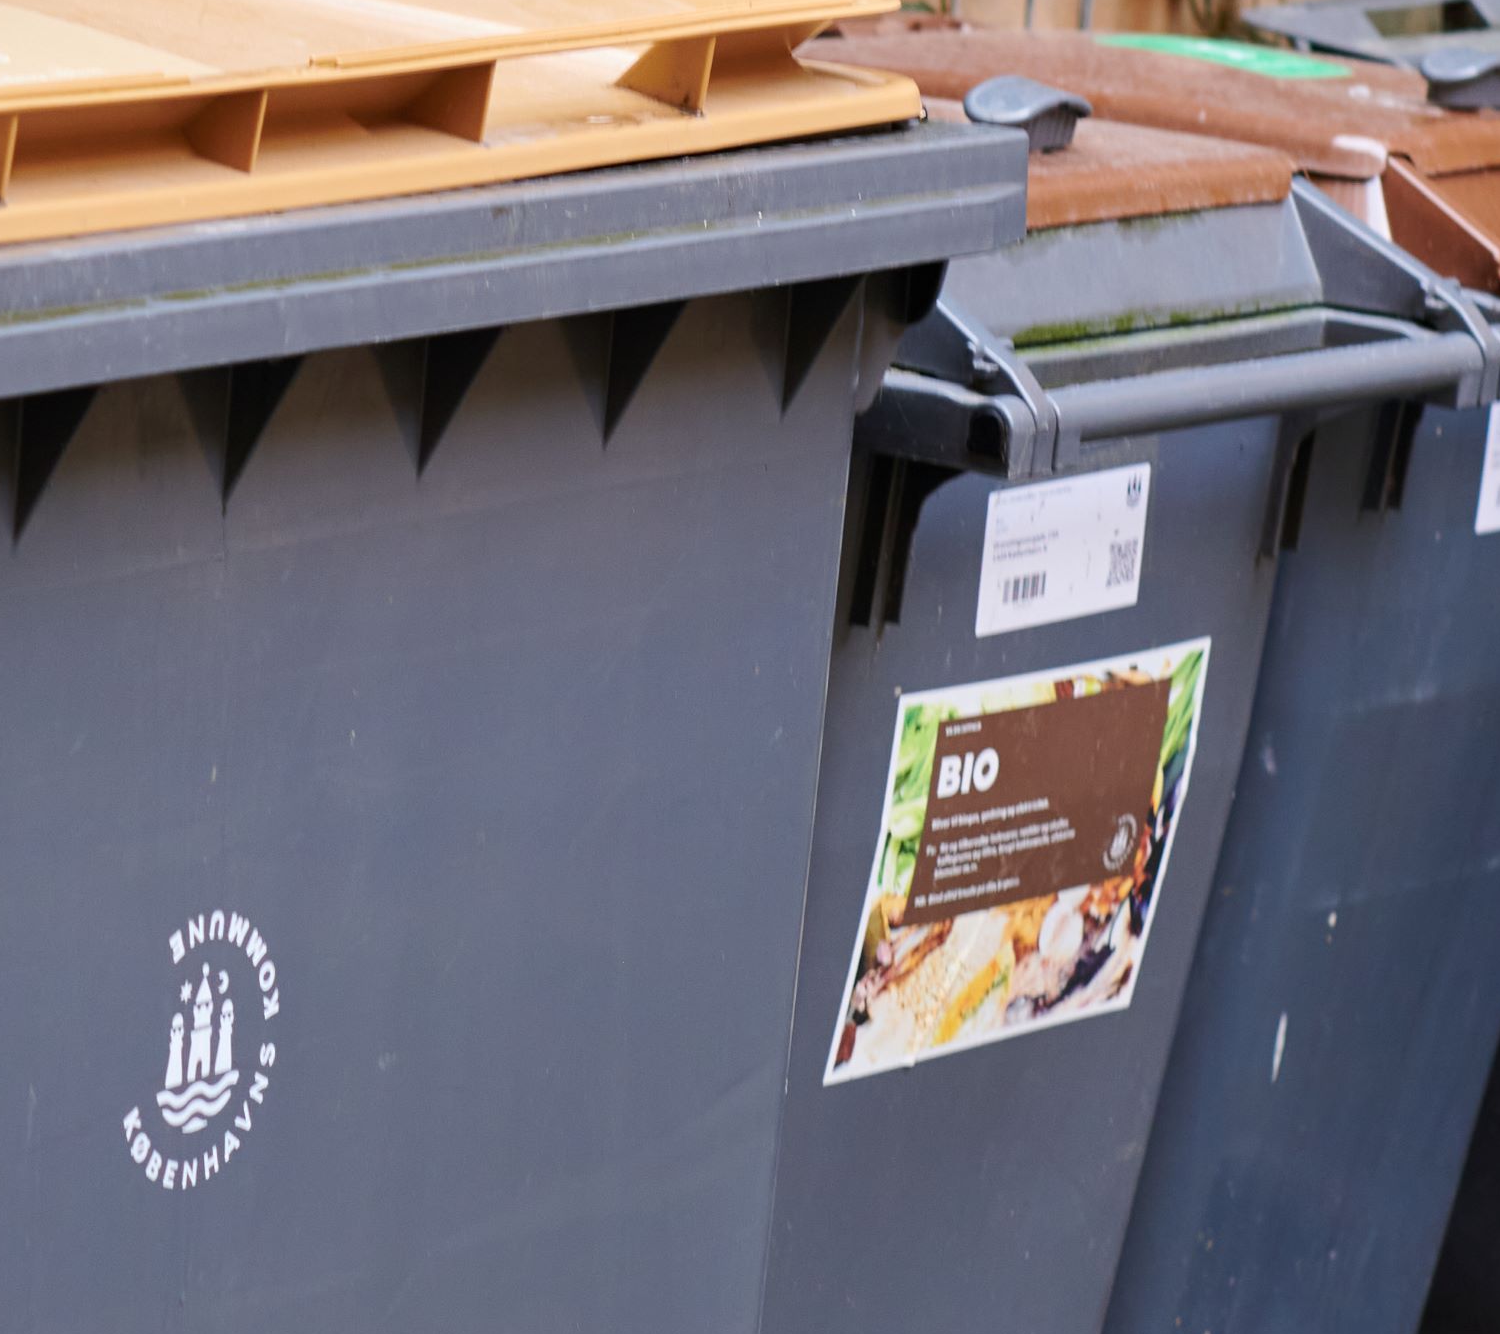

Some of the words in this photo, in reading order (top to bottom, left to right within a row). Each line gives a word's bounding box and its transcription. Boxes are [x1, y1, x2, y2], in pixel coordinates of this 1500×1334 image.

[936, 746, 1000, 799] BIO
[167, 908, 281, 1021] KOMMUNE
[122, 1041, 277, 1191] KØBENHAVNS
